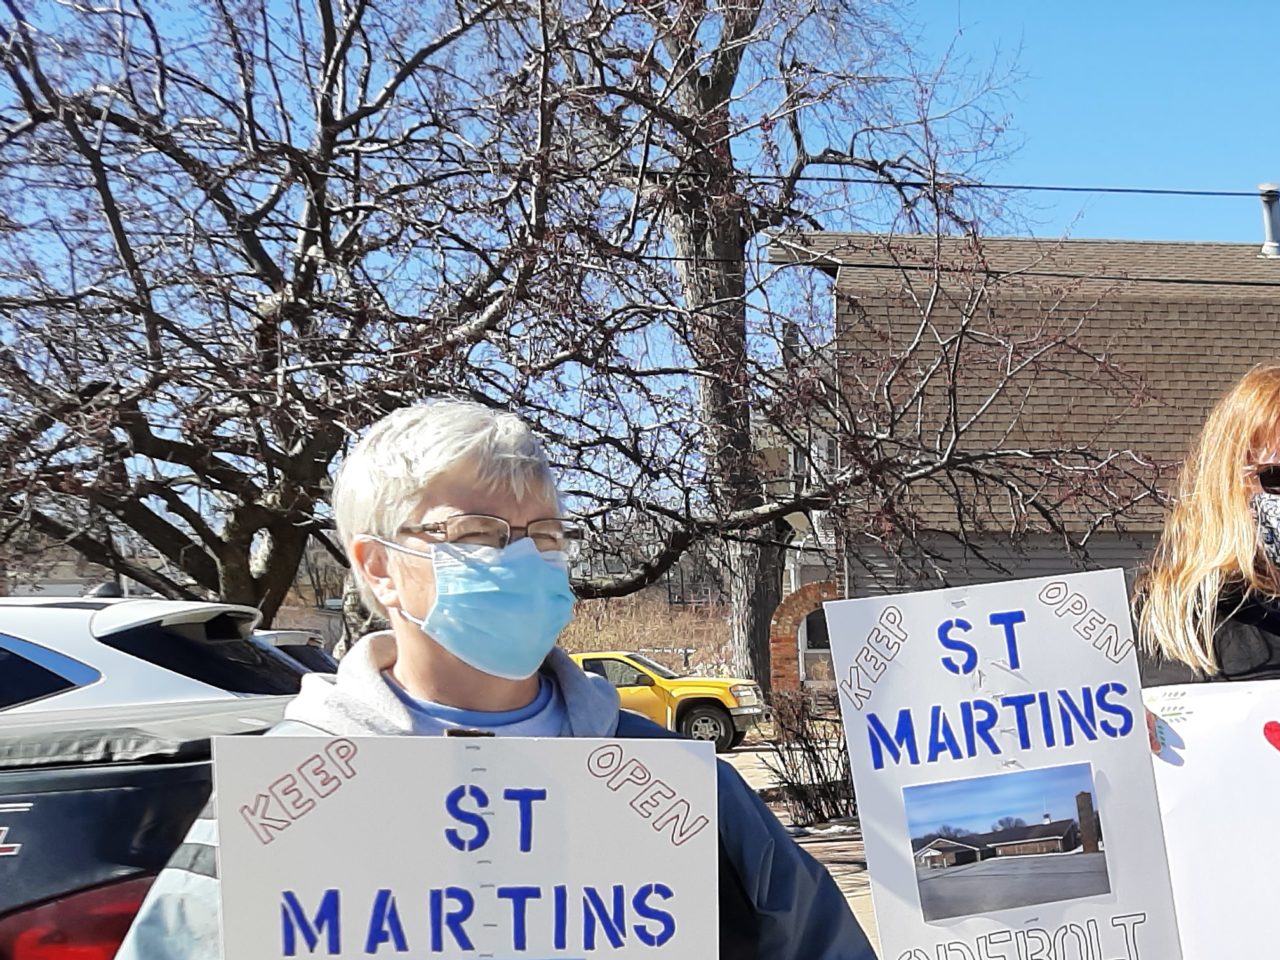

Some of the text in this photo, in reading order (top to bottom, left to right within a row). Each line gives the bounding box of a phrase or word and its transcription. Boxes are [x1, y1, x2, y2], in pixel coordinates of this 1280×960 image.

[841, 605, 907, 710] KEEP
[937, 610, 1027, 675] ST
[1038, 582, 1136, 664] OPEN
[866, 682, 1134, 770] MARTINS
[240, 738, 358, 845] KEEP
[445, 785, 547, 852] ST
[587, 744, 709, 846] OPEN
[280, 883, 677, 957] MARTINS
